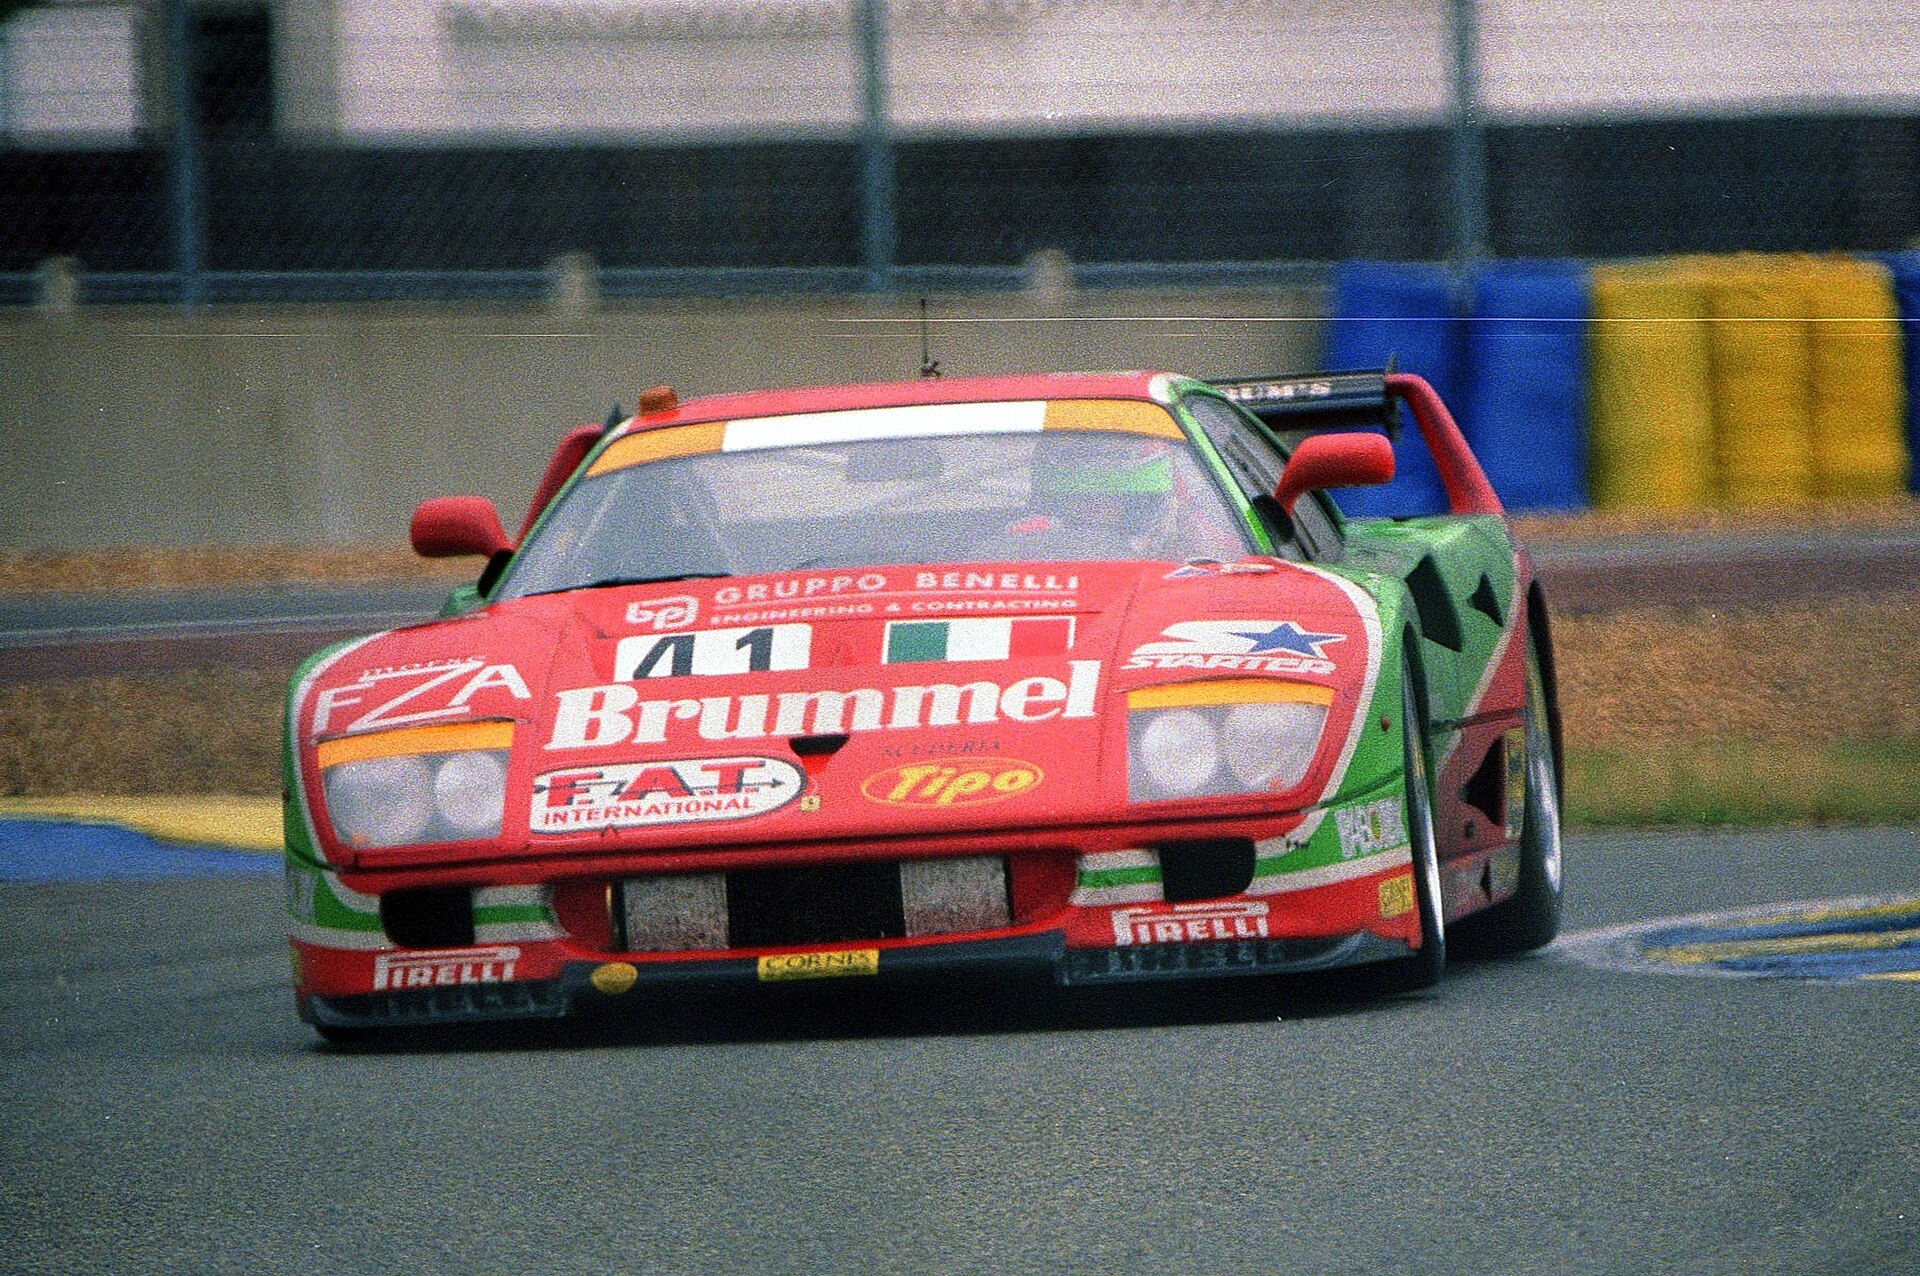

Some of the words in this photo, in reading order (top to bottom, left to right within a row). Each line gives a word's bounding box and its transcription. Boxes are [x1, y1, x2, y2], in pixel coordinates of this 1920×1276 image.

[714, 573, 887, 605] GRUPPO
[916, 571, 1078, 590] BENELLI
[710, 603, 873, 626] ENGINEERING
[885, 602, 901, 613] &
[911, 599, 1078, 612] CONTRACTING
[633, 627, 774, 680] 41
[1120, 654, 1337, 675] STARTER
[544, 659, 1101, 751] Brummel
[888, 764, 1034, 806] Tipo
[544, 796, 755, 826] INTERNATIONAL
[1112, 900, 1270, 948] PIRELLI
[374, 946, 521, 992] PIRELLI
